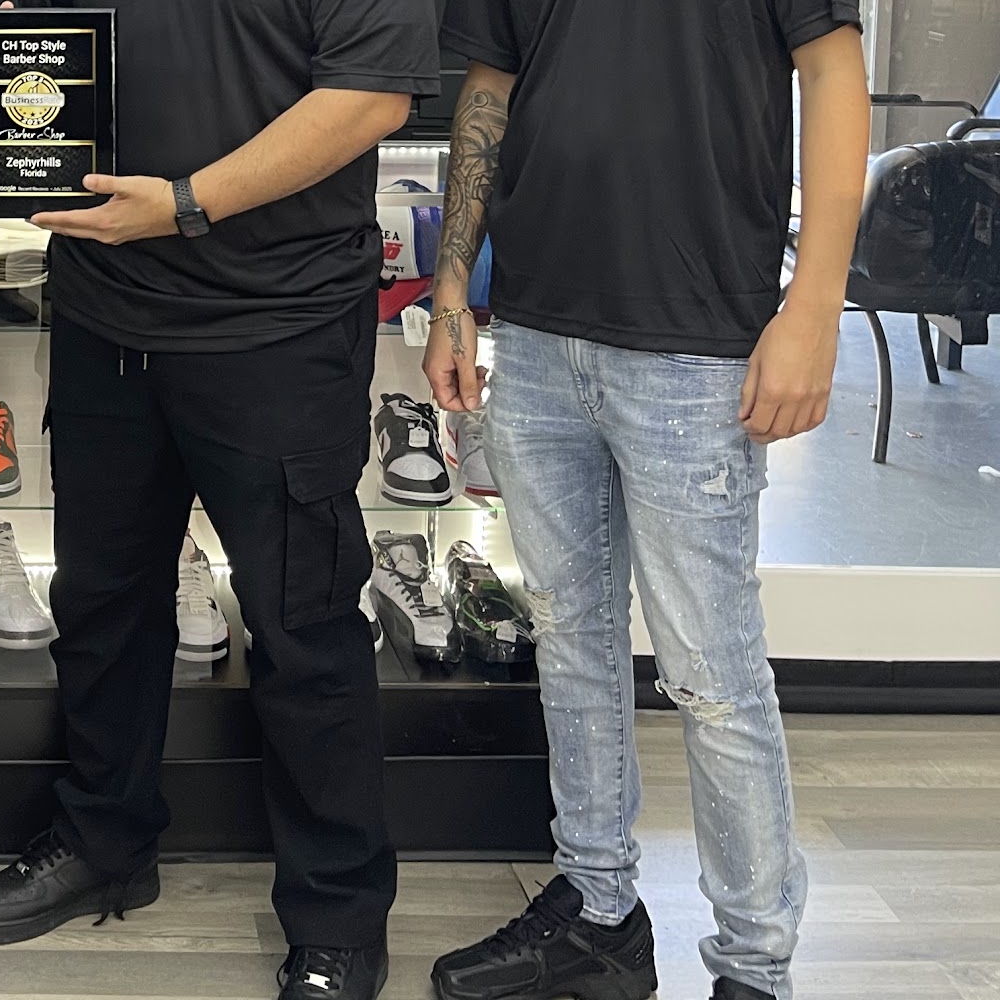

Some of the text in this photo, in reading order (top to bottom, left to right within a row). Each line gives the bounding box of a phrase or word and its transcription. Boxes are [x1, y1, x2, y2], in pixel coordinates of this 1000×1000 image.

[1, 40, 67, 53] CH Top Style
[3, 53, 66, 66] Barber Shop
[36, 126, 66, 141] Shop
[5, 156, 62, 170] Zephyrhills
[20, 169, 48, 178] Florida
[392, 231, 400, 241] A
[383, 264, 405, 273] NDRY
